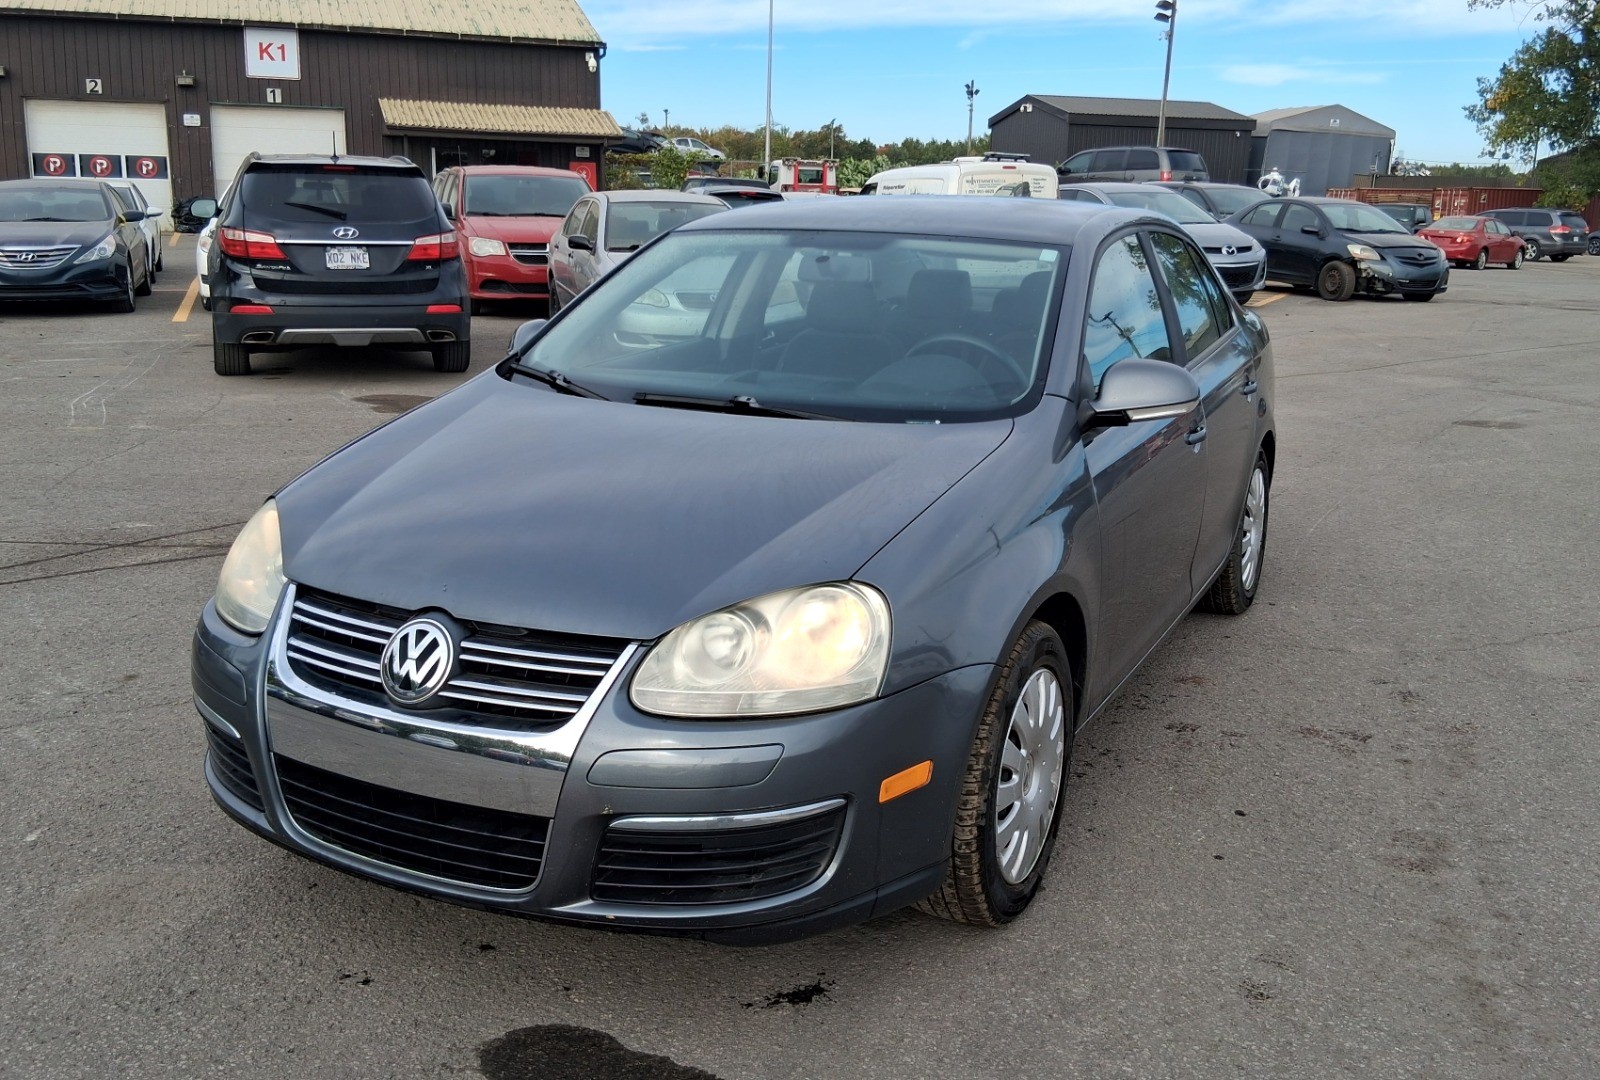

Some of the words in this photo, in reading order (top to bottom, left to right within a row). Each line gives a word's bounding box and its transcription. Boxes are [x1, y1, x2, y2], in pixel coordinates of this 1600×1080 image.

[258, 42, 286, 61] K1
[88, 79, 99, 93] 2
[269, 88, 277, 103] 1
[327, 252, 345, 264] X02
[350, 252, 369, 264] NKE
